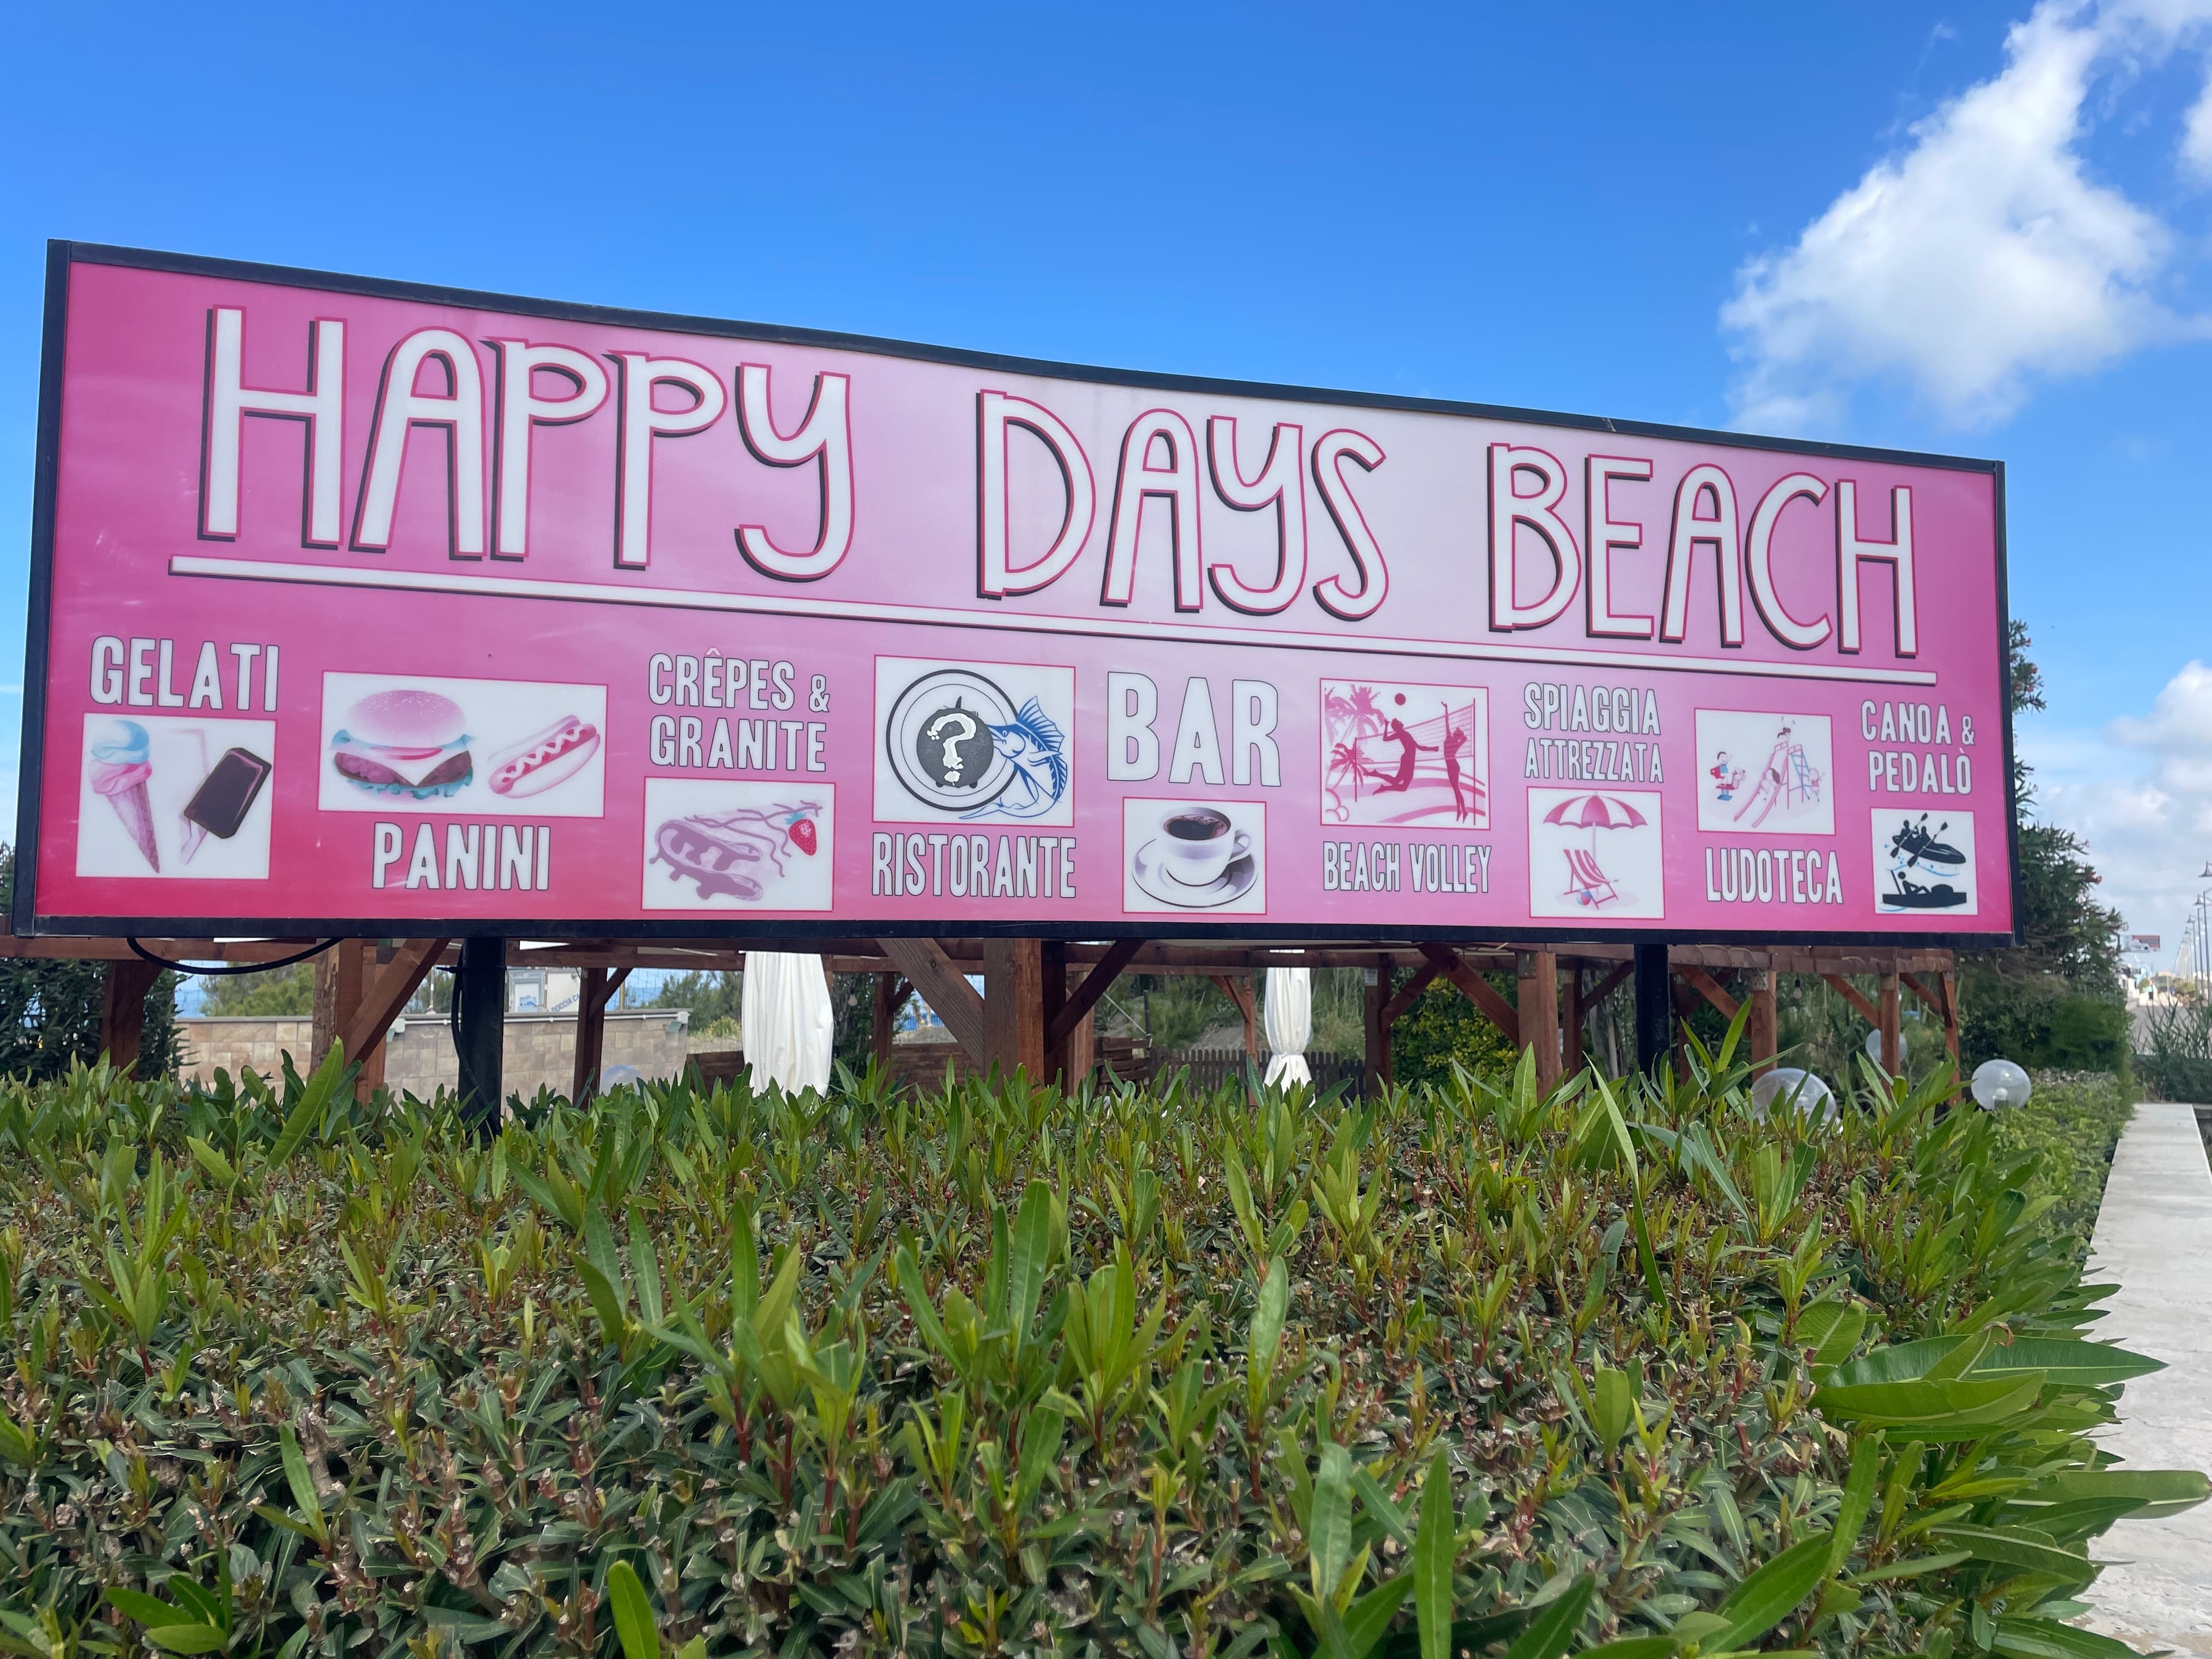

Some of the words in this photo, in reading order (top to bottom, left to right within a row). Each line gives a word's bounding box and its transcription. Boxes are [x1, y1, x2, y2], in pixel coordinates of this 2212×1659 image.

[197, 304, 855, 582] HAPPY
[976, 388, 1389, 620] DAYS
[1487, 442, 1917, 658] BEACH
[89, 635, 280, 712] GELATI
[647, 646, 796, 711] CRÊPES
[808, 673, 831, 713] &
[1107, 671, 1282, 787] BAR
[1523, 682, 1661, 736] SPIAGGIA
[1861, 699, 1952, 745] CANOA
[1961, 714, 1976, 746] &
[649, 714, 827, 772] GRANITE
[1524, 737, 1664, 784] ATTREZZATA
[1869, 747, 1972, 795] PEDALÒ
[372, 821, 551, 891] PANINI
[872, 832, 1077, 899] RISTORANTE
[1323, 841, 1401, 892] BEACH
[1410, 844, 1493, 893] VOLLEY
[1705, 847, 1844, 904] LUDOTECA
